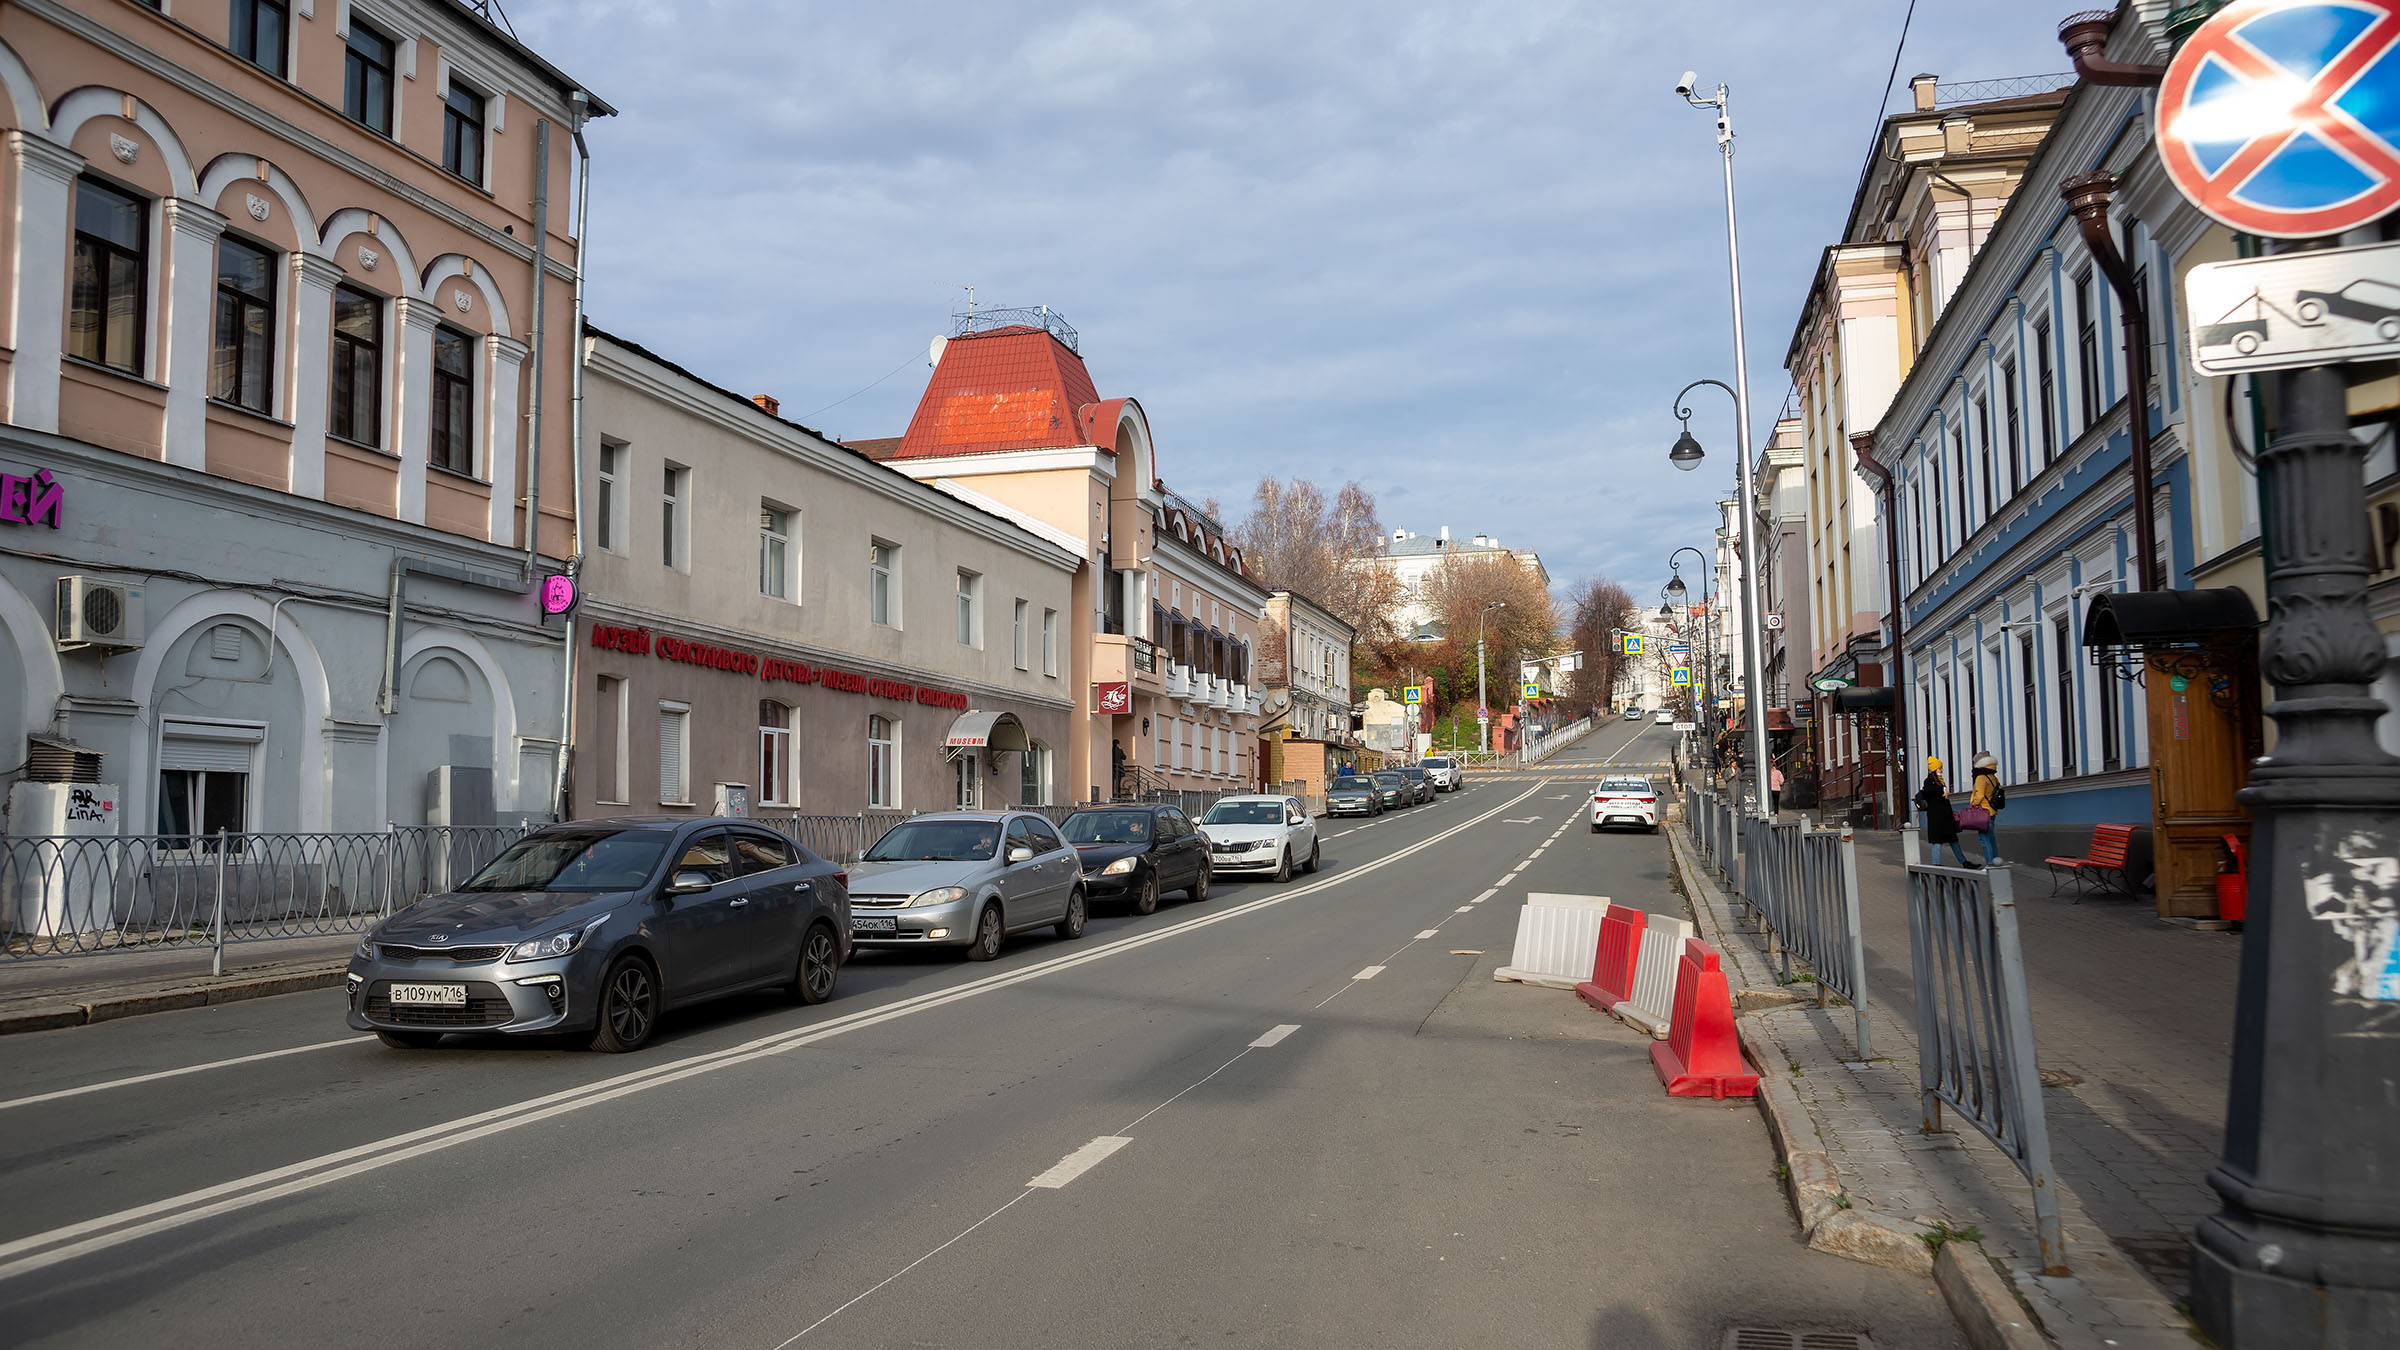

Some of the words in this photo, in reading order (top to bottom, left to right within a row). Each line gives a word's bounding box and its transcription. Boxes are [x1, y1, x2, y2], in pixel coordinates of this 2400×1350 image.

[0, 468, 65, 530] ЕЙ
[592, 623, 650, 655] МУЗЕЙ
[655, 635, 759, 676] СЧАСТЛИВОГО
[761, 656, 814, 684] ДЕТСТВА
[821, 667, 868, 694] MUSEUM
[884, 680, 916, 702] HAPPY
[917, 686, 968, 710] CHILDHOOD
[949, 737, 984, 745] MUSEUM
[395, 987, 442, 1001] В109УМ
[443, 986, 462, 998] 716
